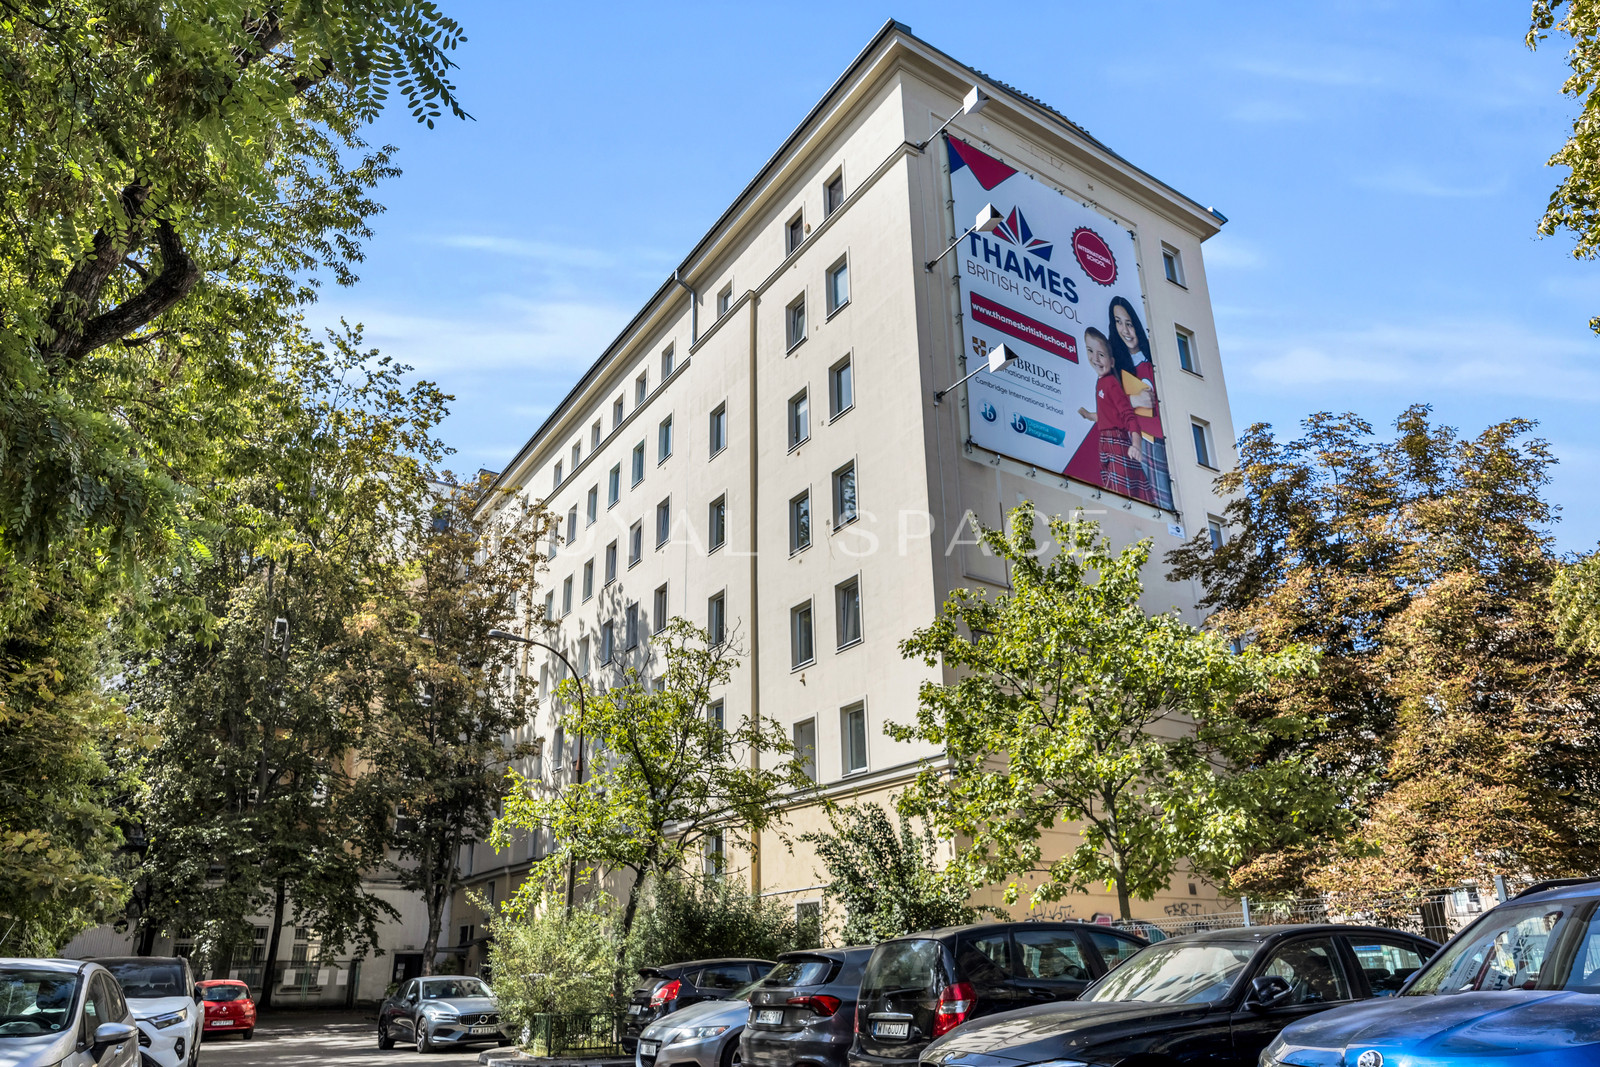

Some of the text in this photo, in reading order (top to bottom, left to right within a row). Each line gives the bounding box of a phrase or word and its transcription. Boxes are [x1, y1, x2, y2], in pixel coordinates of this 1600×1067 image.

[964, 228, 1079, 304] THAMES
[1077, 243, 1112, 266] INTERNATIONAL
[1086, 253, 1106, 268] SCHOOL
[967, 259, 1082, 324] BRITISH SCHOOL
[972, 303, 1076, 354] www.thamesbritishschool.pl
[975, 376, 1064, 415] Cambridge International School
[1031, 377, 1062, 395] Education
